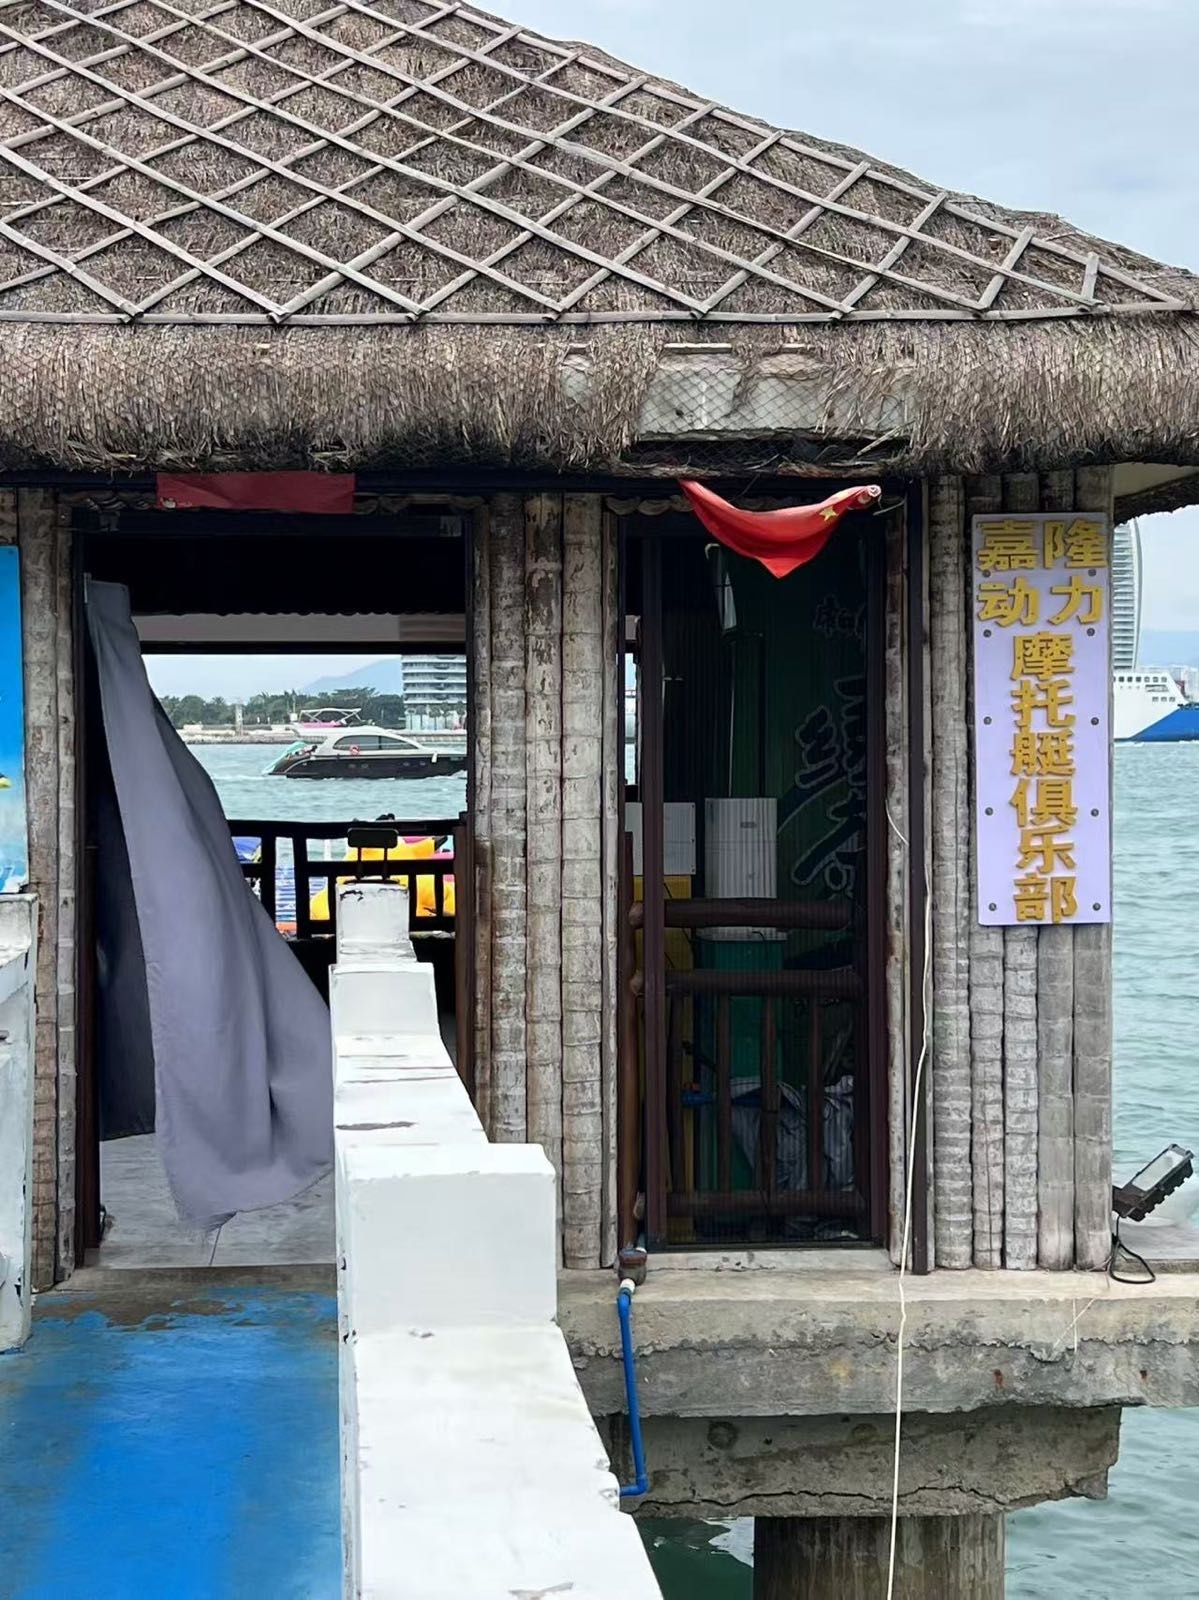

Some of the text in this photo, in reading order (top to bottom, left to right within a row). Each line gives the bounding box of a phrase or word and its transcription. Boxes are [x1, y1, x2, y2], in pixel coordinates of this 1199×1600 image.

[977, 519, 1107, 572] 嘉隆
[977, 576, 1102, 627] 动力
[1009, 632, 1078, 926] 摩托艇俱乐部
